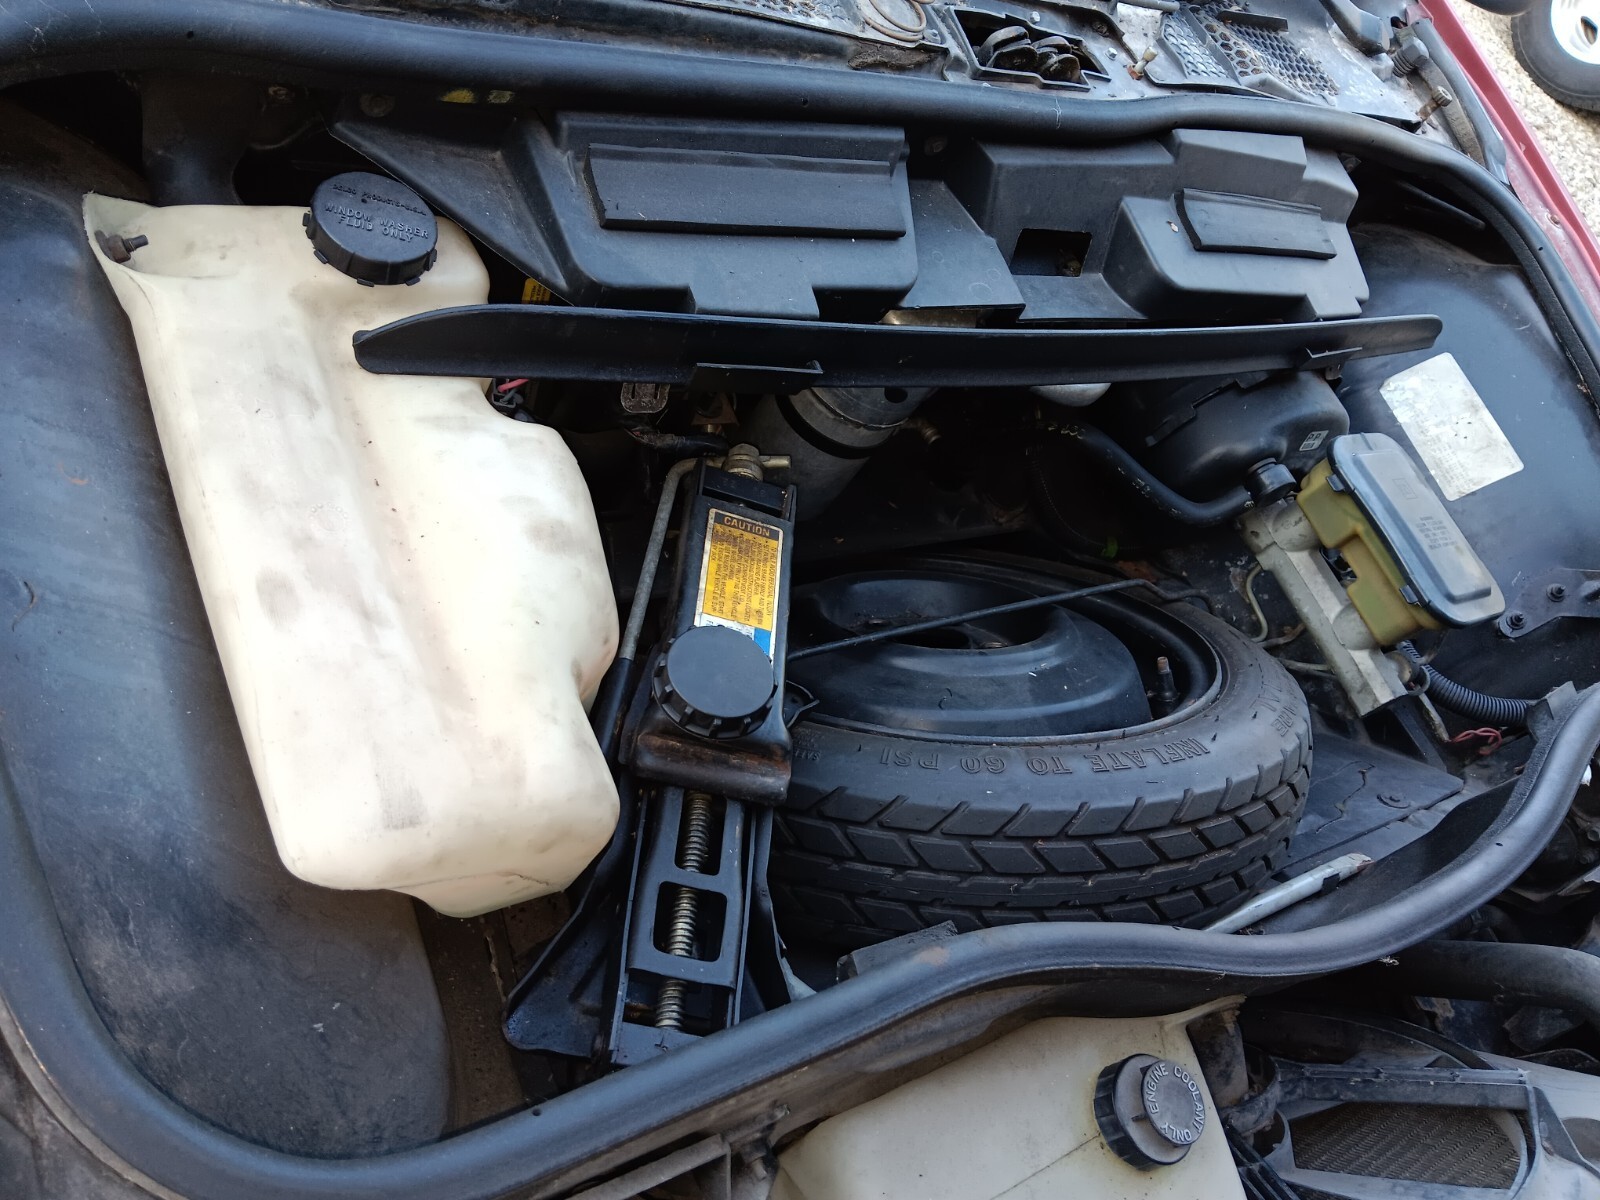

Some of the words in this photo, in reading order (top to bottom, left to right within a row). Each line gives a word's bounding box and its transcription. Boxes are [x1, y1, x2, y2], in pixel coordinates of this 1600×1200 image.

[324, 202, 373, 222] WINDOW
[379, 218, 429, 239] WASHER
[338, 215, 373, 231] FLUID
[382, 227, 414, 243] ONLY
[723, 515, 770, 537] CAUTION
[880, 747, 939, 770] PSI
[960, 755, 1007, 774] 60
[1026, 755, 1073, 775] TO
[1083, 737, 1211, 772] INFLATE
[1147, 1062, 1169, 1114] ENGINE
[1173, 1066, 1205, 1133] COOLANT
[1160, 1121, 1191, 1142] ONLY
